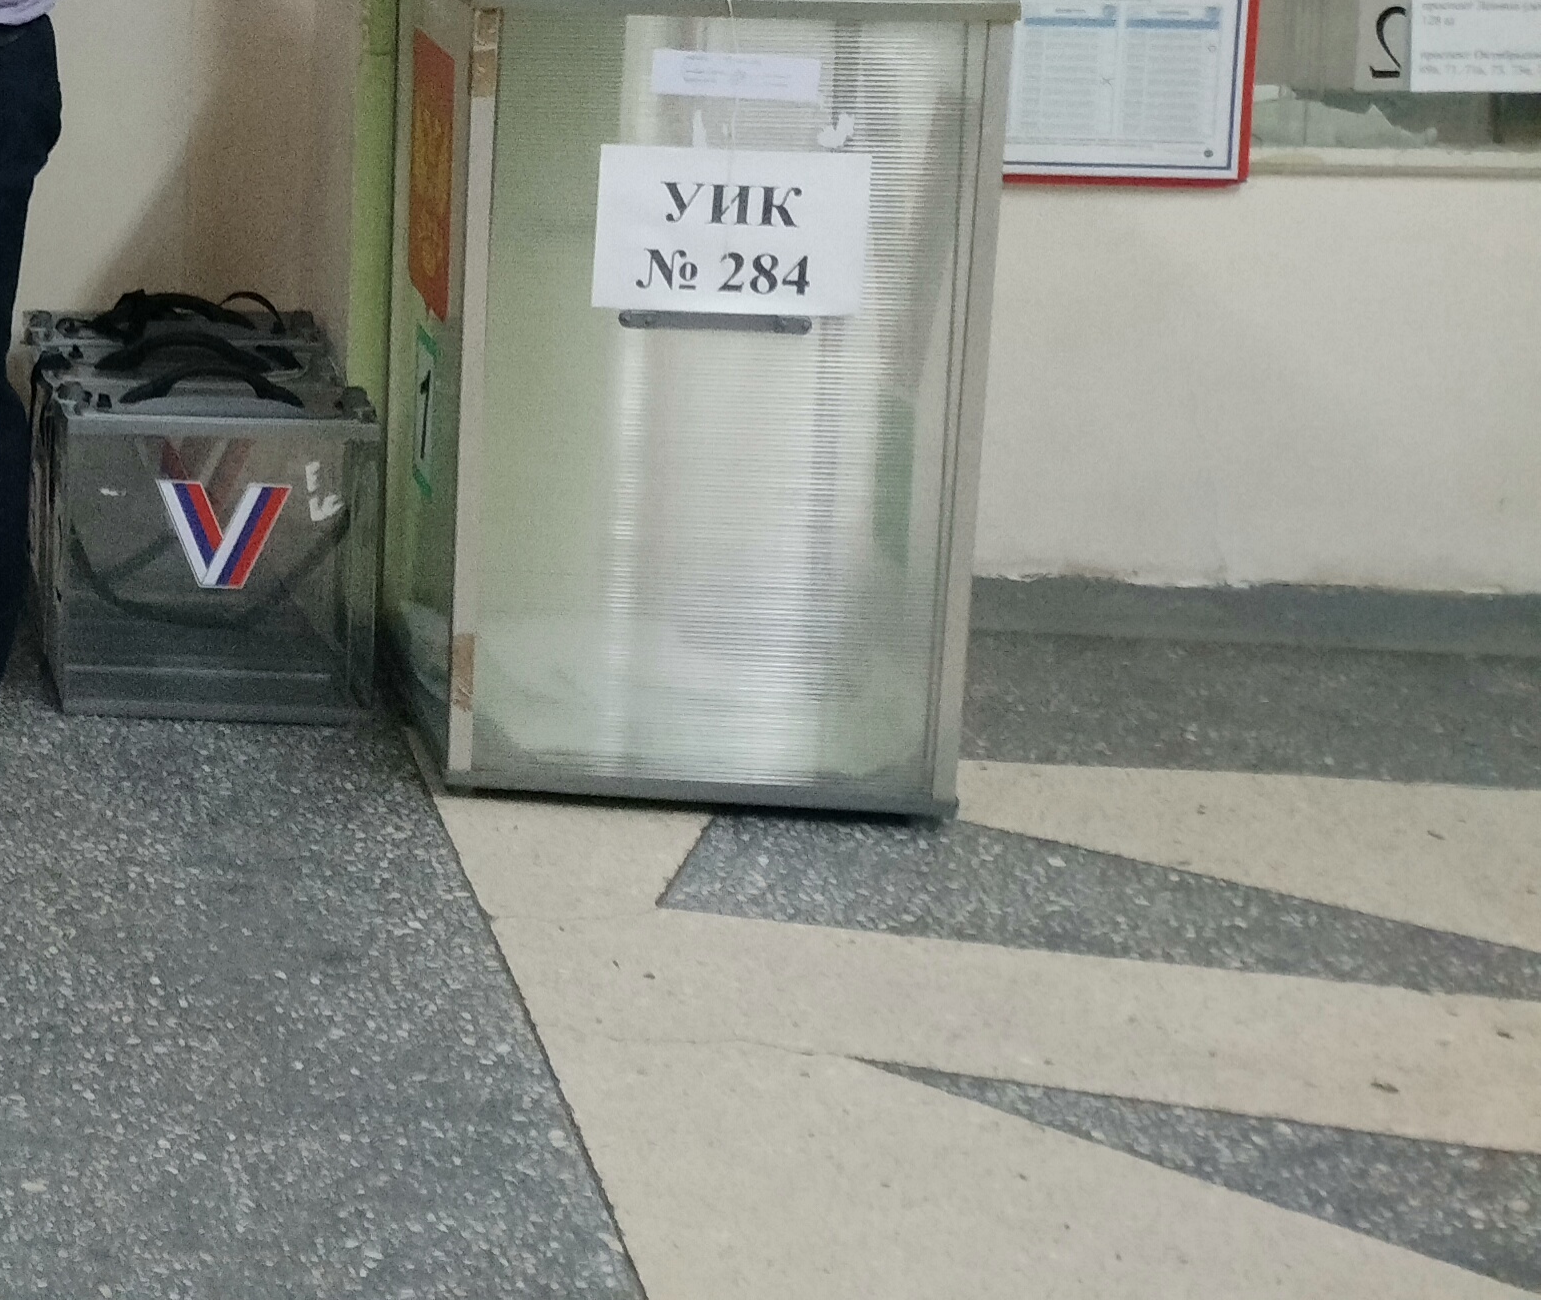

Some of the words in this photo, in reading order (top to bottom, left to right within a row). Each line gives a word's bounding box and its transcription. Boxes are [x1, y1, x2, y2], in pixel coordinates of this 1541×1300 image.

[661, 181, 803, 228] УИК
[636, 248, 698, 291] №
[718, 251, 810, 296] 284
